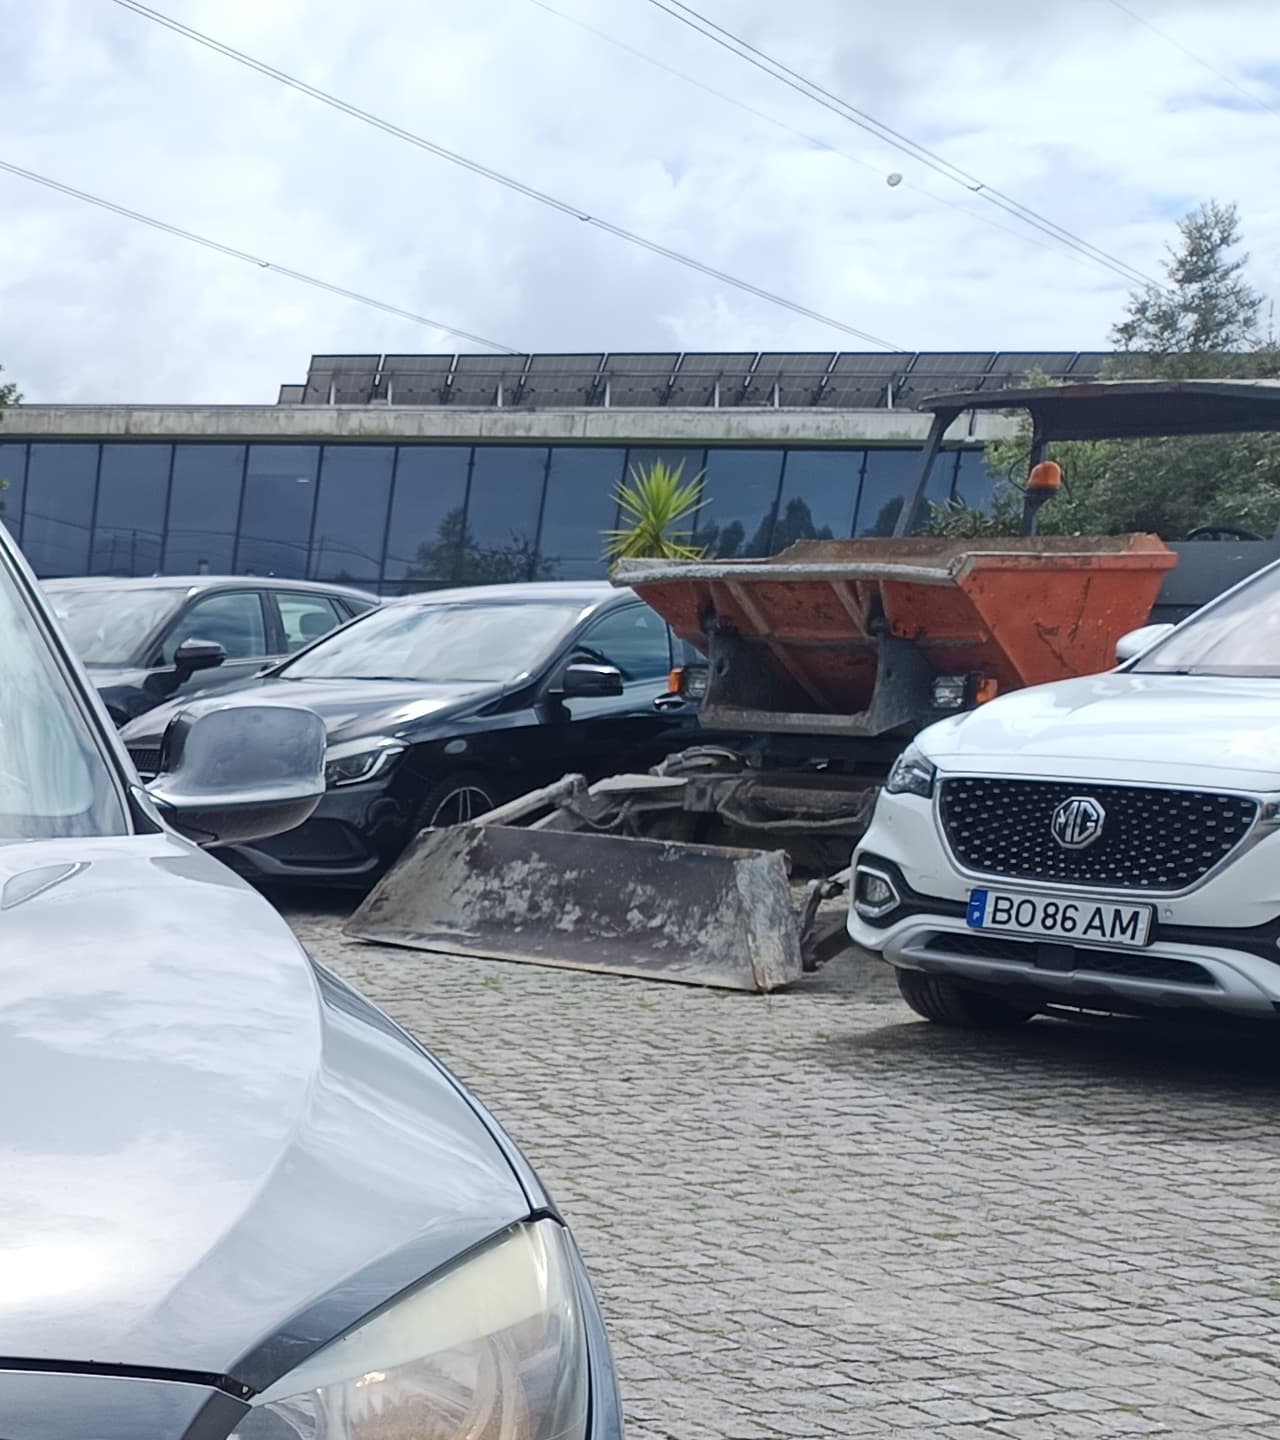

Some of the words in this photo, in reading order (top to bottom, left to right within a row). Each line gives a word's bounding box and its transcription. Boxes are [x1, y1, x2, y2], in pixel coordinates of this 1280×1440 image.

[1055, 800, 1098, 843] MG
[972, 910, 981, 921] P
[1041, 902, 1080, 933] 86
[1082, 906, 1141, 941] AM
